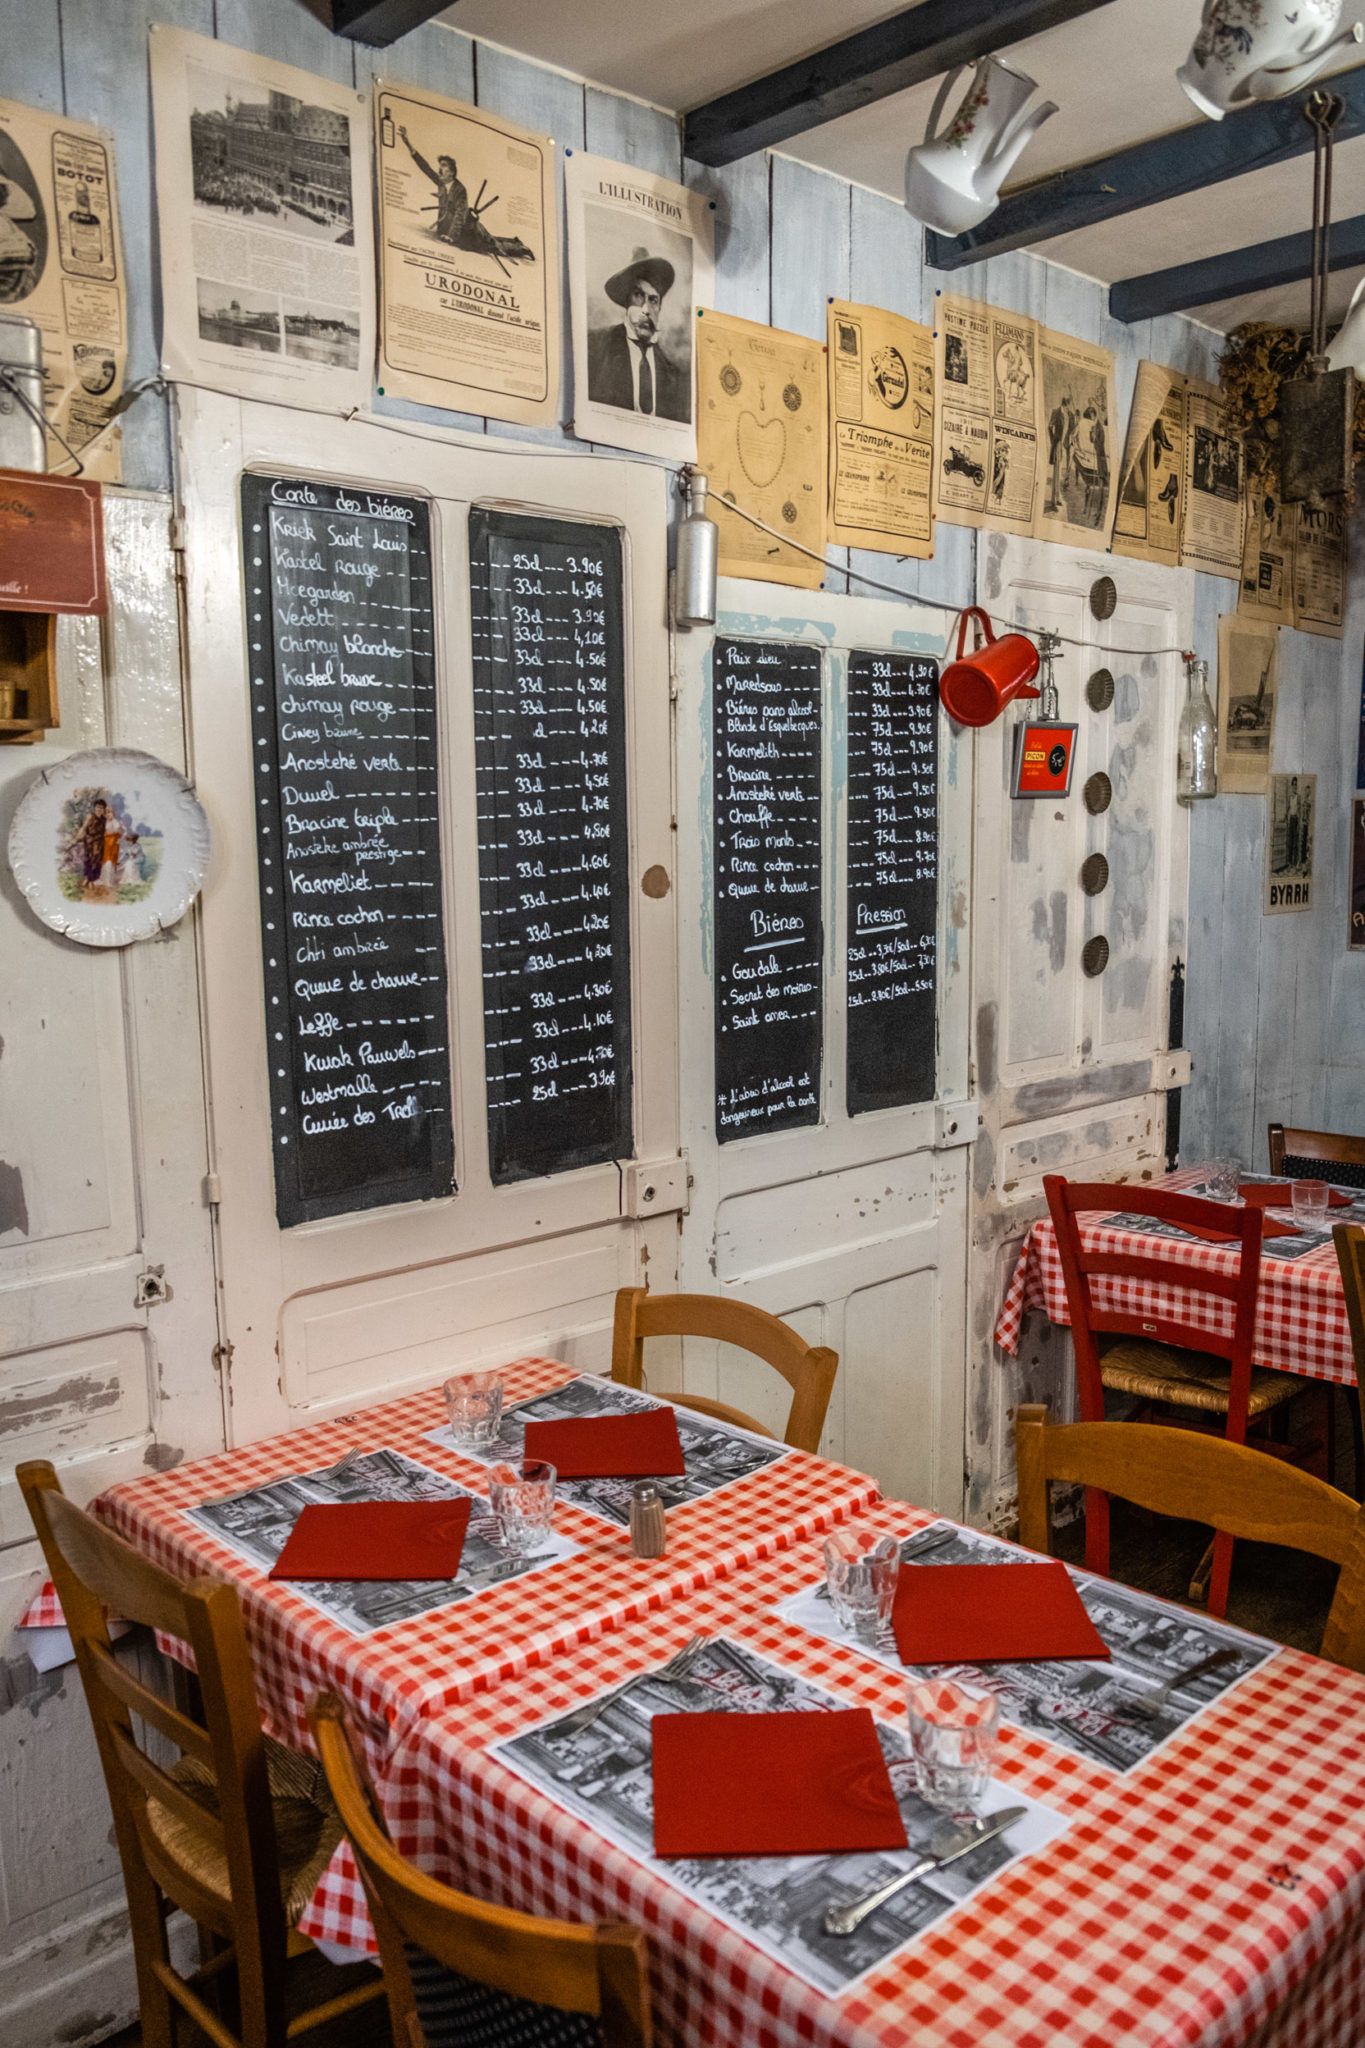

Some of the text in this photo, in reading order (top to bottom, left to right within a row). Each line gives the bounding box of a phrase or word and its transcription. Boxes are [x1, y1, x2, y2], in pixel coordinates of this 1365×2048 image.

[57, 168, 103, 185] BOTOT
[599, 181, 682, 221] L'ILLUSTRATION
[425, 272, 520, 308] URODONAL
[848, 428, 894, 449] Triomphe
[336, 490, 361, 513] des
[271, 511, 407, 552] Kriek Saint Louis
[278, 602, 334, 627] Vedett
[343, 633, 403, 658] blanche
[726, 647, 783, 666] Paix dieu
[282, 660, 337, 687] Kasteel
[726, 673, 783, 696] Maredsous
[763, 705, 785, 717] sans
[788, 698, 813, 717] alcool
[1026, 752, 1044, 761] PICON
[282, 779, 341, 805] Duvel
[285, 806, 399, 835] Bracine triple
[729, 804, 775, 830] Chouffe
[730, 829, 795, 849] Trois monts
[355, 848, 403, 866] prestige
[731, 856, 795, 874] Rince cochon
[289, 868, 372, 895] Karmeliet
[728, 882, 761, 900] Queue
[764, 876, 776, 894] de
[1270, 883, 1310, 907] BYRRH
[293, 905, 384, 928] Rince cochon
[857, 903, 907, 926] Pression
[732, 954, 782, 979] Goudale
[295, 969, 422, 1003] Queue de charrue
[730, 984, 764, 1006] Secret
[766, 983, 780, 998] des
[299, 1012, 343, 1038] Leffe
[732, 1008, 760, 1030] Saint
[304, 1039, 416, 1073] Kwak Pauwels
[302, 1073, 378, 1105] Westmalle
[730, 1086, 760, 1104] L'abus
[762, 1076, 795, 1095] d'alcool
[767, 1101, 786, 1117] pour
[787, 1095, 797, 1108] la
[303, 1103, 376, 1135] Cuvée des
